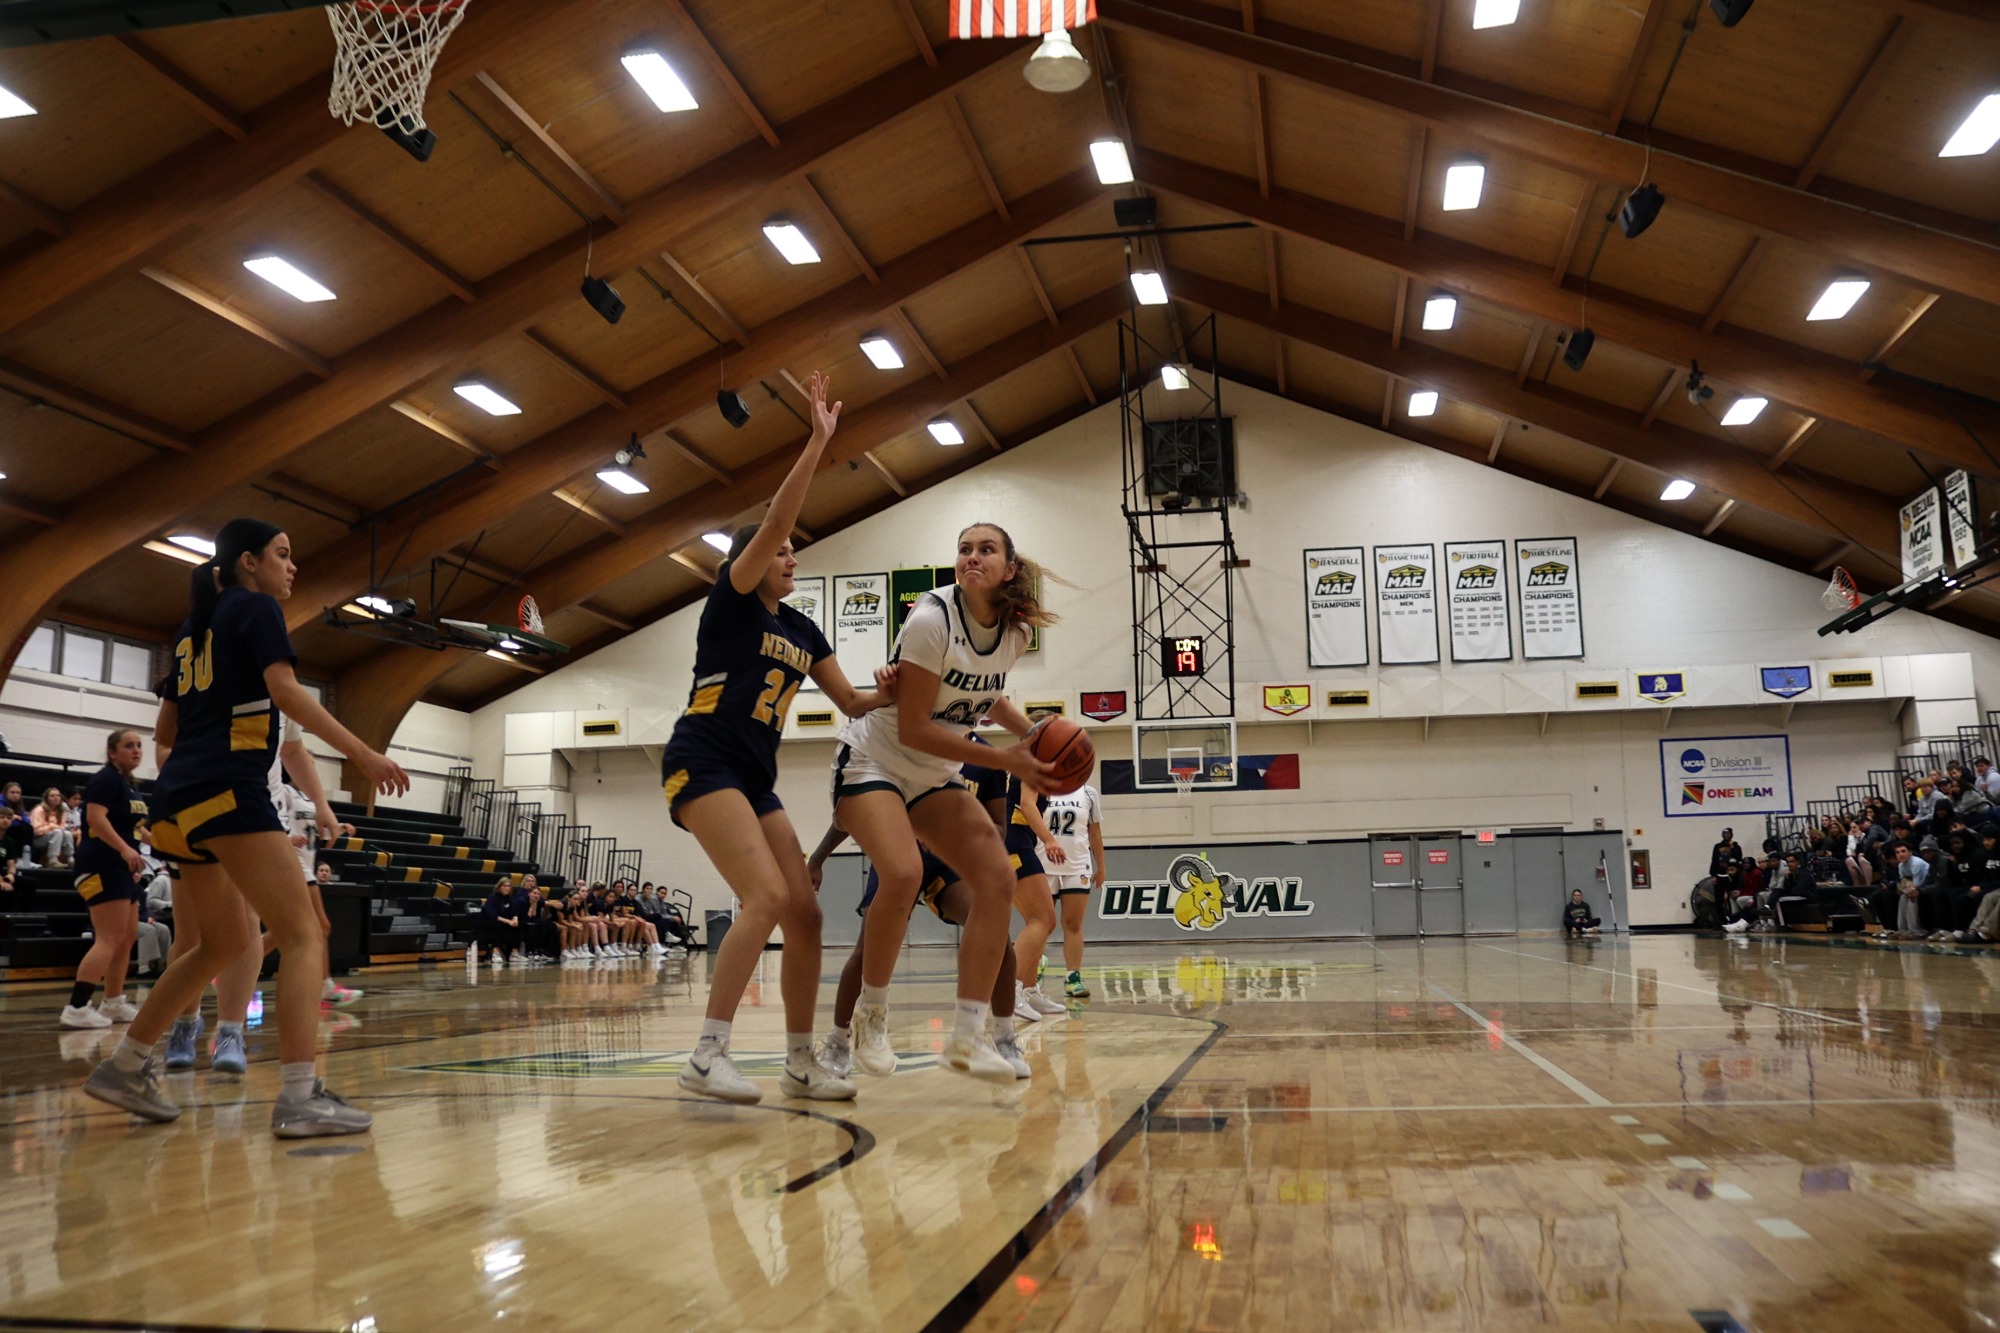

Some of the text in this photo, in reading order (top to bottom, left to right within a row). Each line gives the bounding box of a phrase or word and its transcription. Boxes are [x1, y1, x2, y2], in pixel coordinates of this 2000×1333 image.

[1462, 552, 1500, 560] FOOTBALL
[1529, 549, 1572, 557] WRESTLING
[1320, 558, 1360, 566] BASEBALL
[1386, 576, 1423, 588] MAC
[1458, 576, 1495, 588] MAC
[1529, 573, 1566, 585] MAC
[853, 581, 875, 589] GOLF
[1316, 583, 1353, 595] MAC
[1382, 592, 1431, 601] CHAMPIONS
[1453, 595, 1503, 604] CHAMPIONS
[1525, 592, 1574, 601] CHAMPIONS
[844, 603, 877, 615] MAC
[1312, 601, 1361, 610] CHAMPIONS
[839, 619, 884, 628] CHAMPIONS
[175, 628, 214, 697] 30
[1178, 652, 1195, 672] 19
[750, 668, 801, 733] 24
[1683, 760, 1705, 768] NCAA
[1711, 757, 1751, 768] Division
[1707, 787, 1773, 799] ONETEAM
[1048, 800, 1083, 809] ELVAL
[1049, 809, 1077, 836] 42
[1102, 880, 1310, 916] DEL VAL
